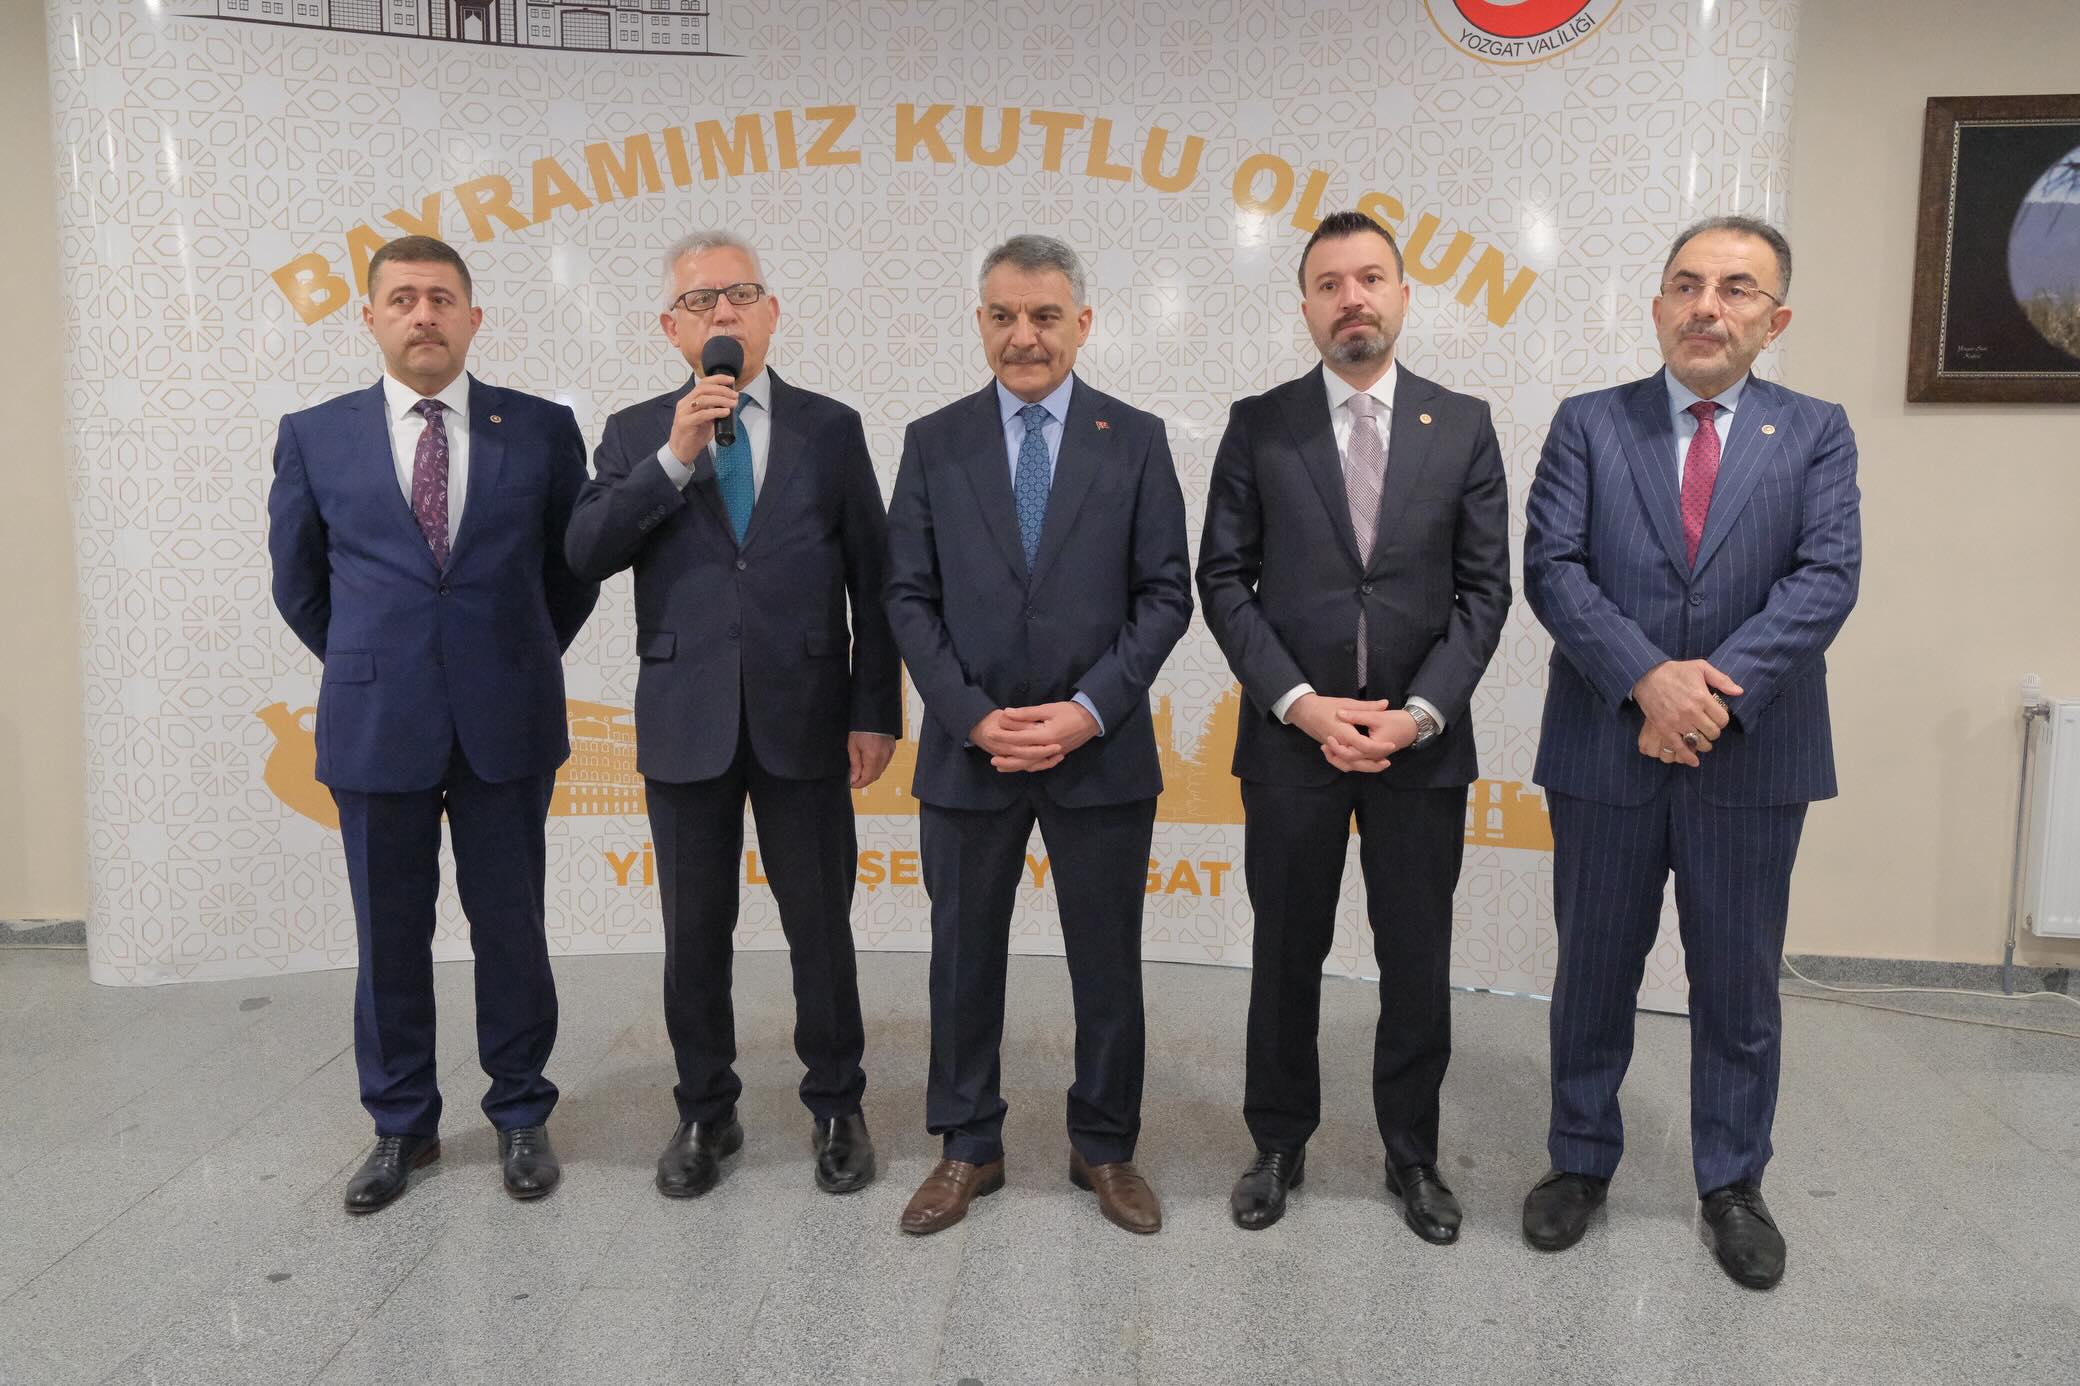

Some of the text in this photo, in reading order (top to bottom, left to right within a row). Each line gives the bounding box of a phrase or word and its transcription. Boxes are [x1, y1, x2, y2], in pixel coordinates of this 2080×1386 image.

[1459, 12, 1596, 57] YOZGAT VALİLİĞİ
[271, 103, 1538, 328] BAYRAMIMIZ KUTLU OLSUN
